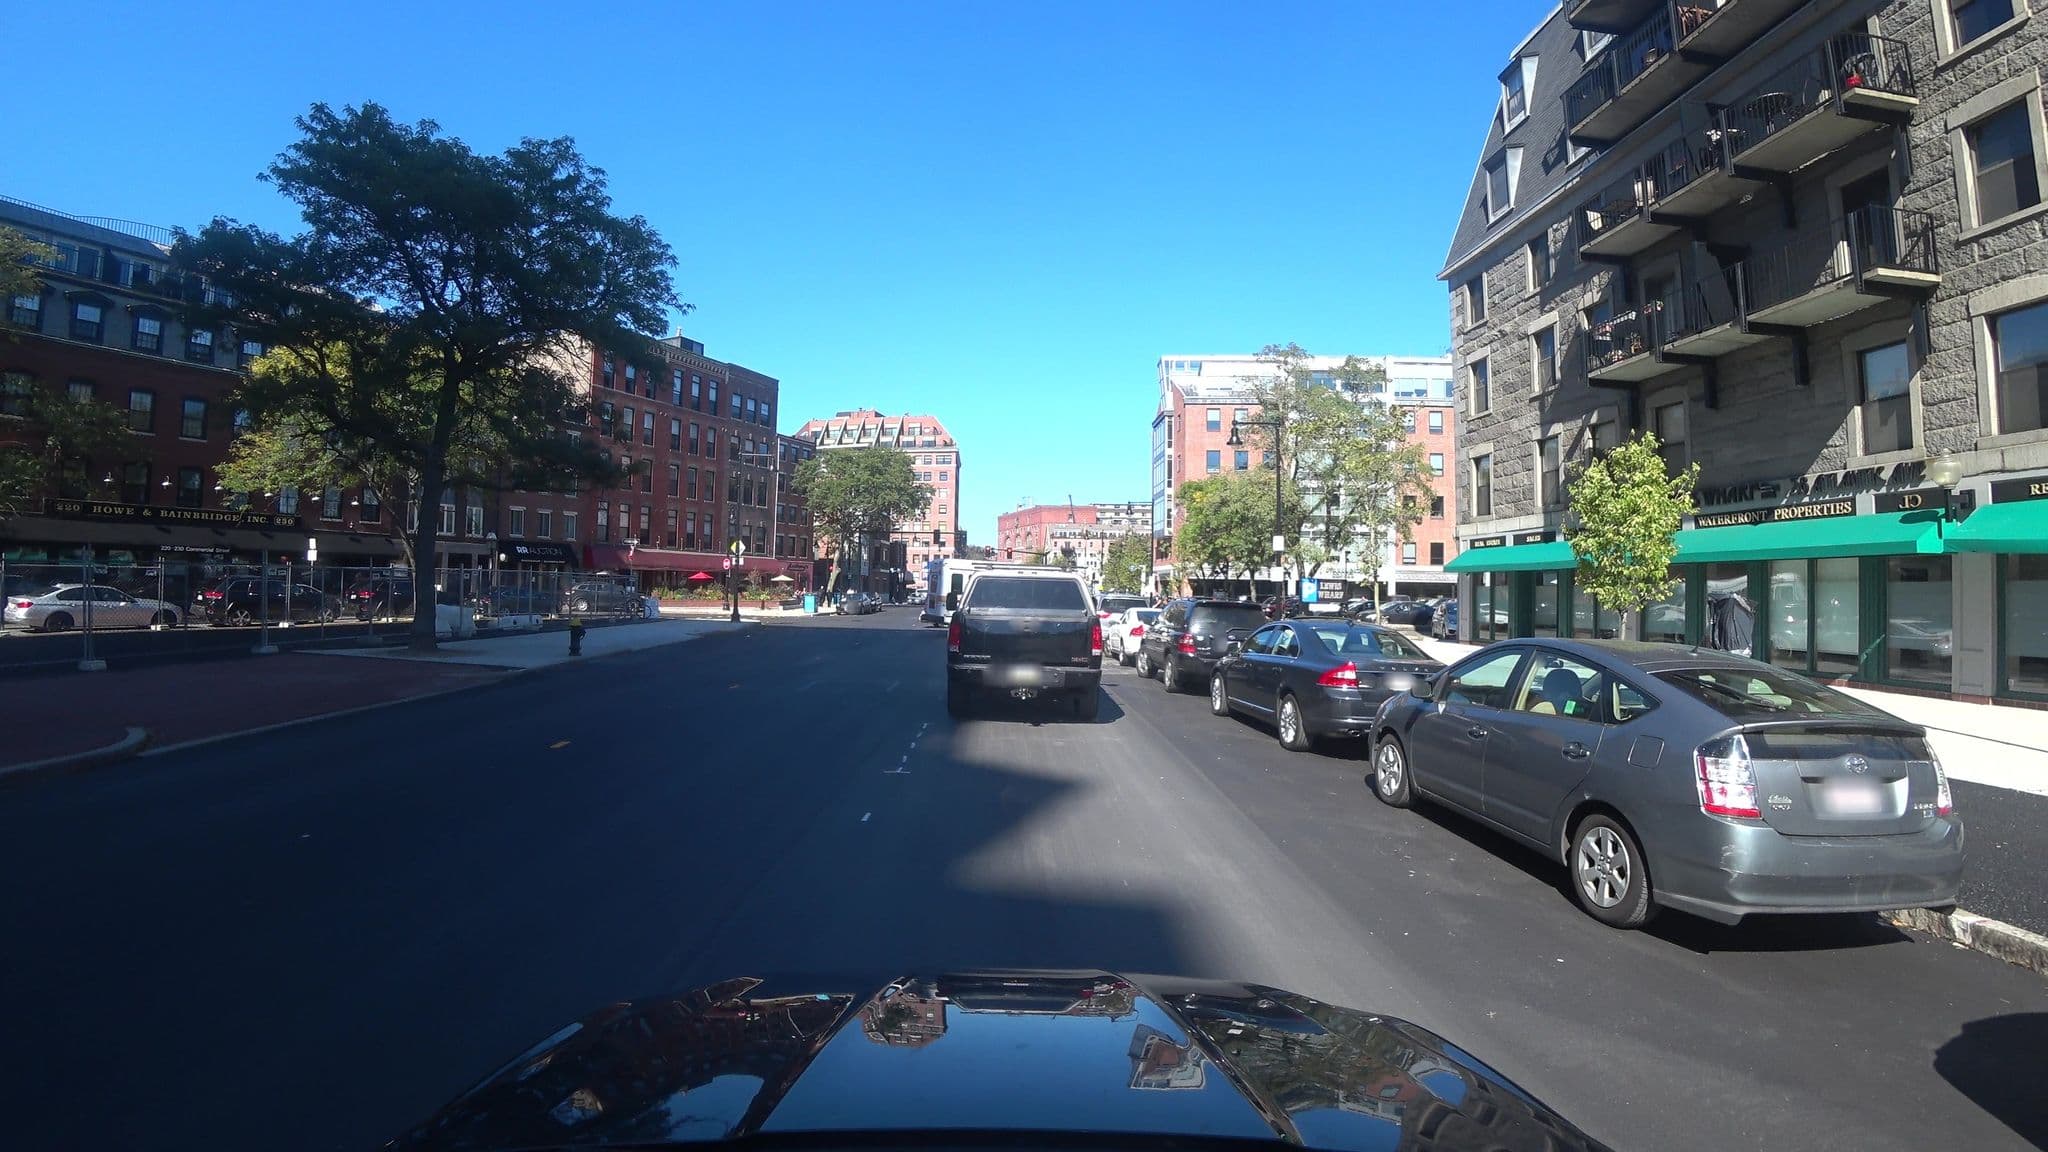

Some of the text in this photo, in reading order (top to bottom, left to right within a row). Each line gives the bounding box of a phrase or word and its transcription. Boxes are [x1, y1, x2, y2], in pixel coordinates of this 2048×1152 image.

[56, 503, 80, 512] 220
[92, 505, 135, 515] HOWE
[143, 508, 152, 517] &
[1698, 501, 1852, 527] WATERFRONT PROPERTIES
[1319, 582, 1342, 590] LEWIS
[1318, 591, 1344, 599] WHARF
